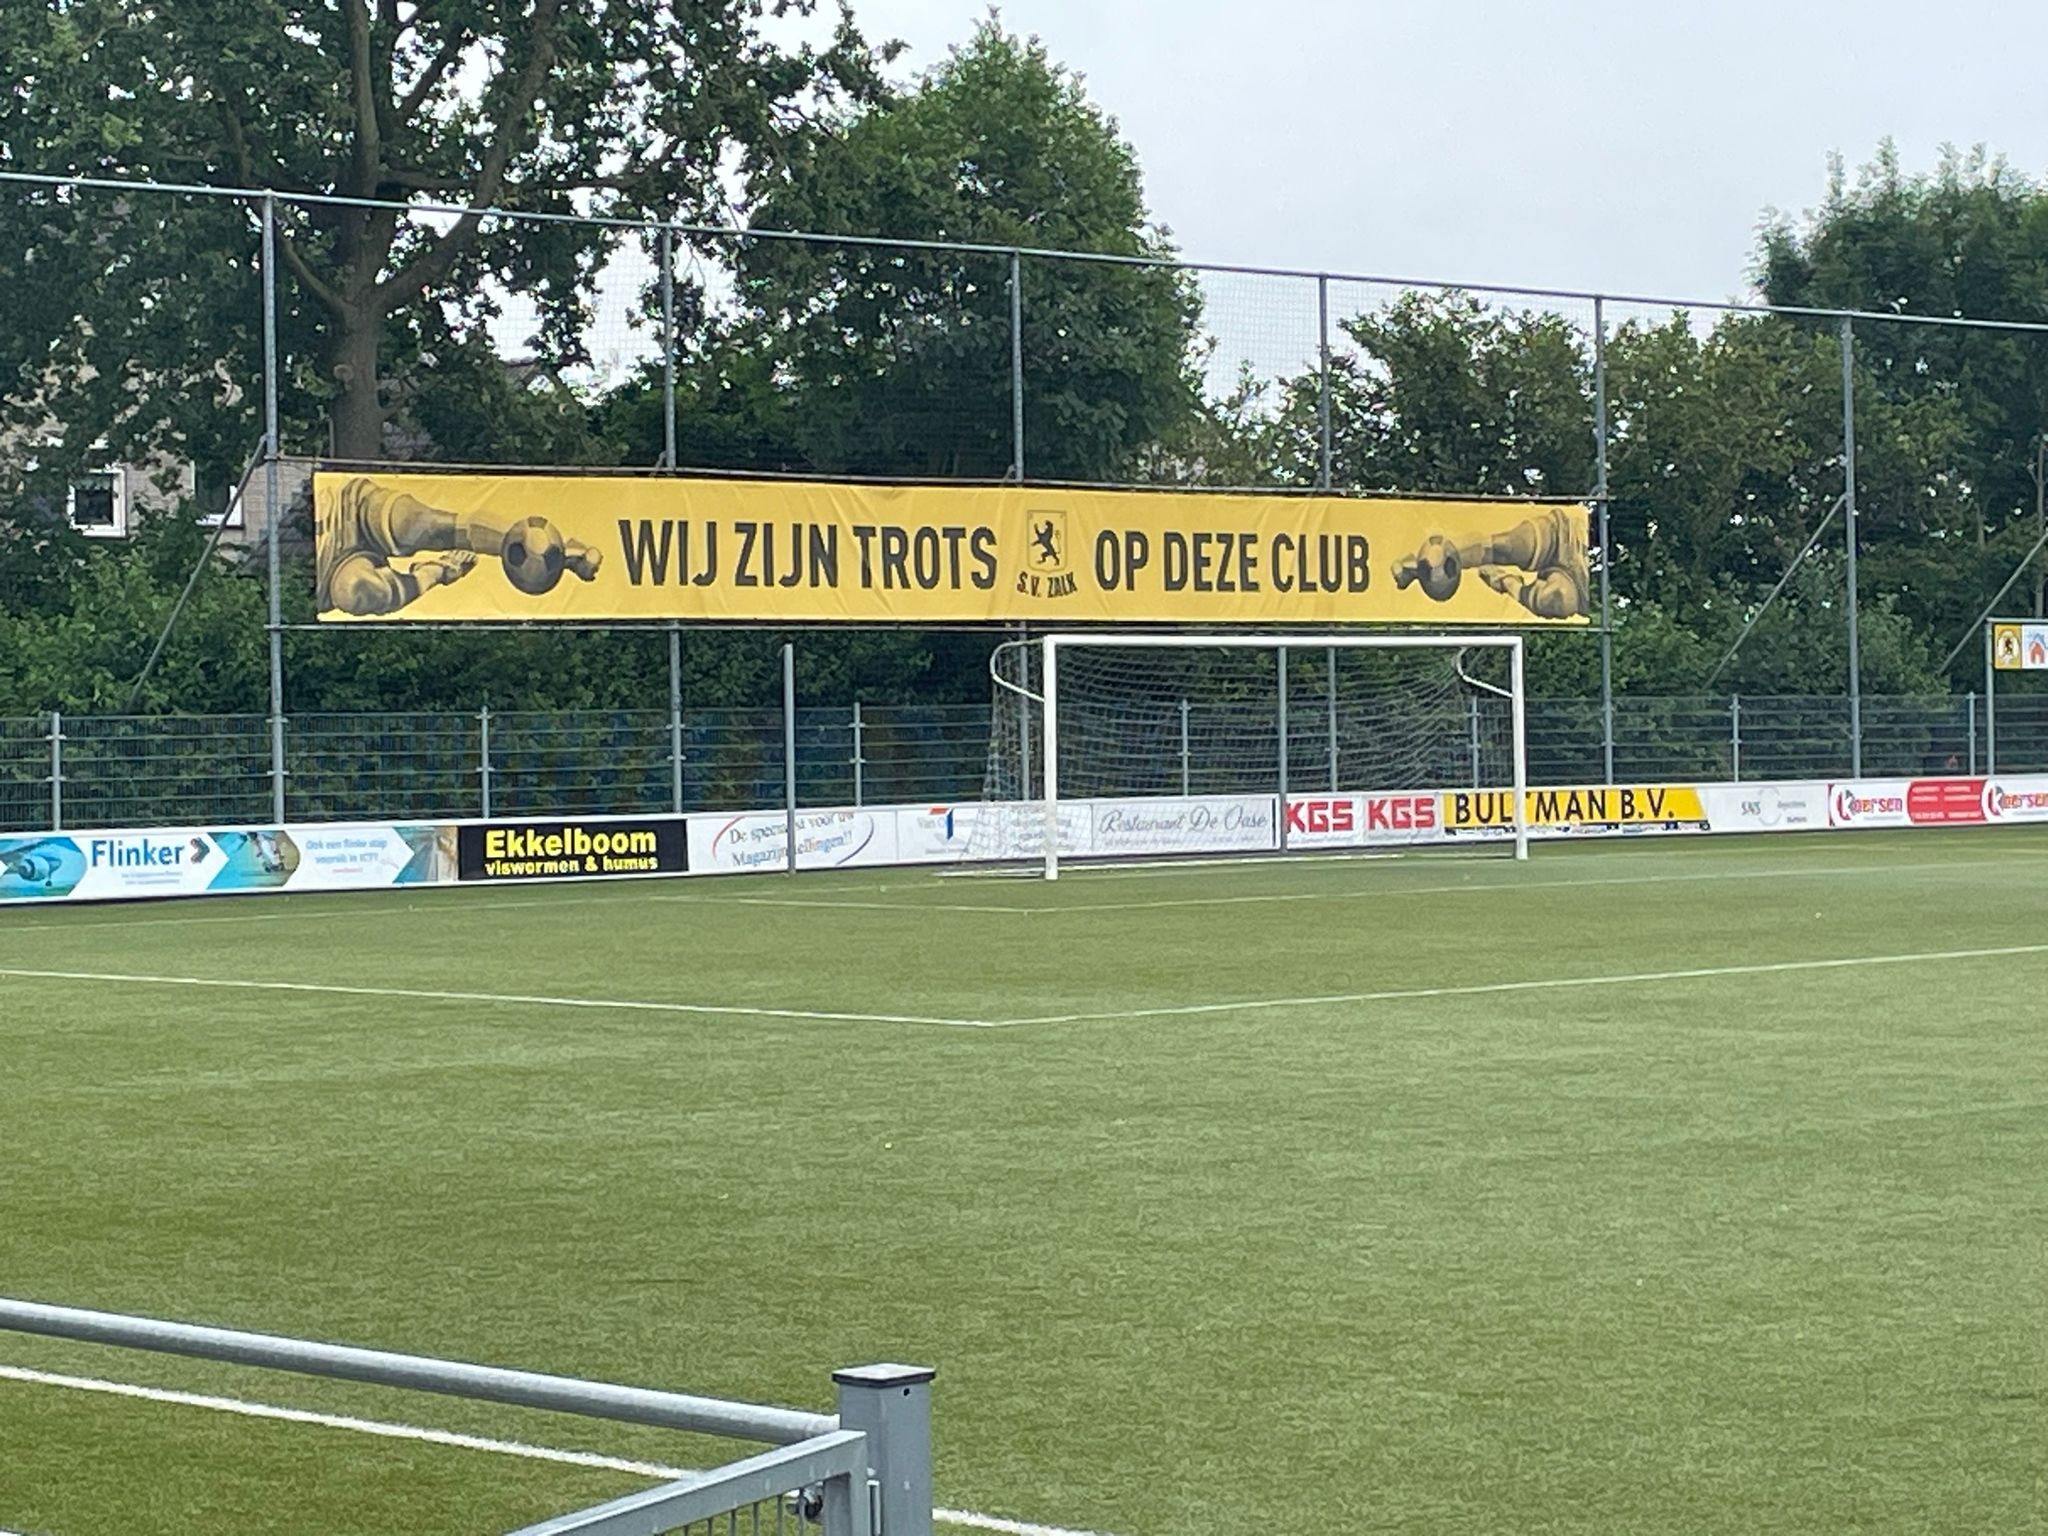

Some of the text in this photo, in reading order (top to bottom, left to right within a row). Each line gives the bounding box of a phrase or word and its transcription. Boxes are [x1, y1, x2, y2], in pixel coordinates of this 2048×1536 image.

[618, 519, 1370, 593] WIJ ZIJN TROTS OP DEZE CLUB
[1017, 571, 1078, 598] S.V. ZALK
[1187, 804, 1218, 832] De
[1286, 801, 1353, 833] KGS
[1367, 797, 1435, 830] KGS
[1455, 788, 1675, 824] BULMAN B.V.
[92, 838, 185, 868] Flinker
[485, 828, 657, 858] Ekkelboom
[485, 855, 658, 876] viswormen & humus
